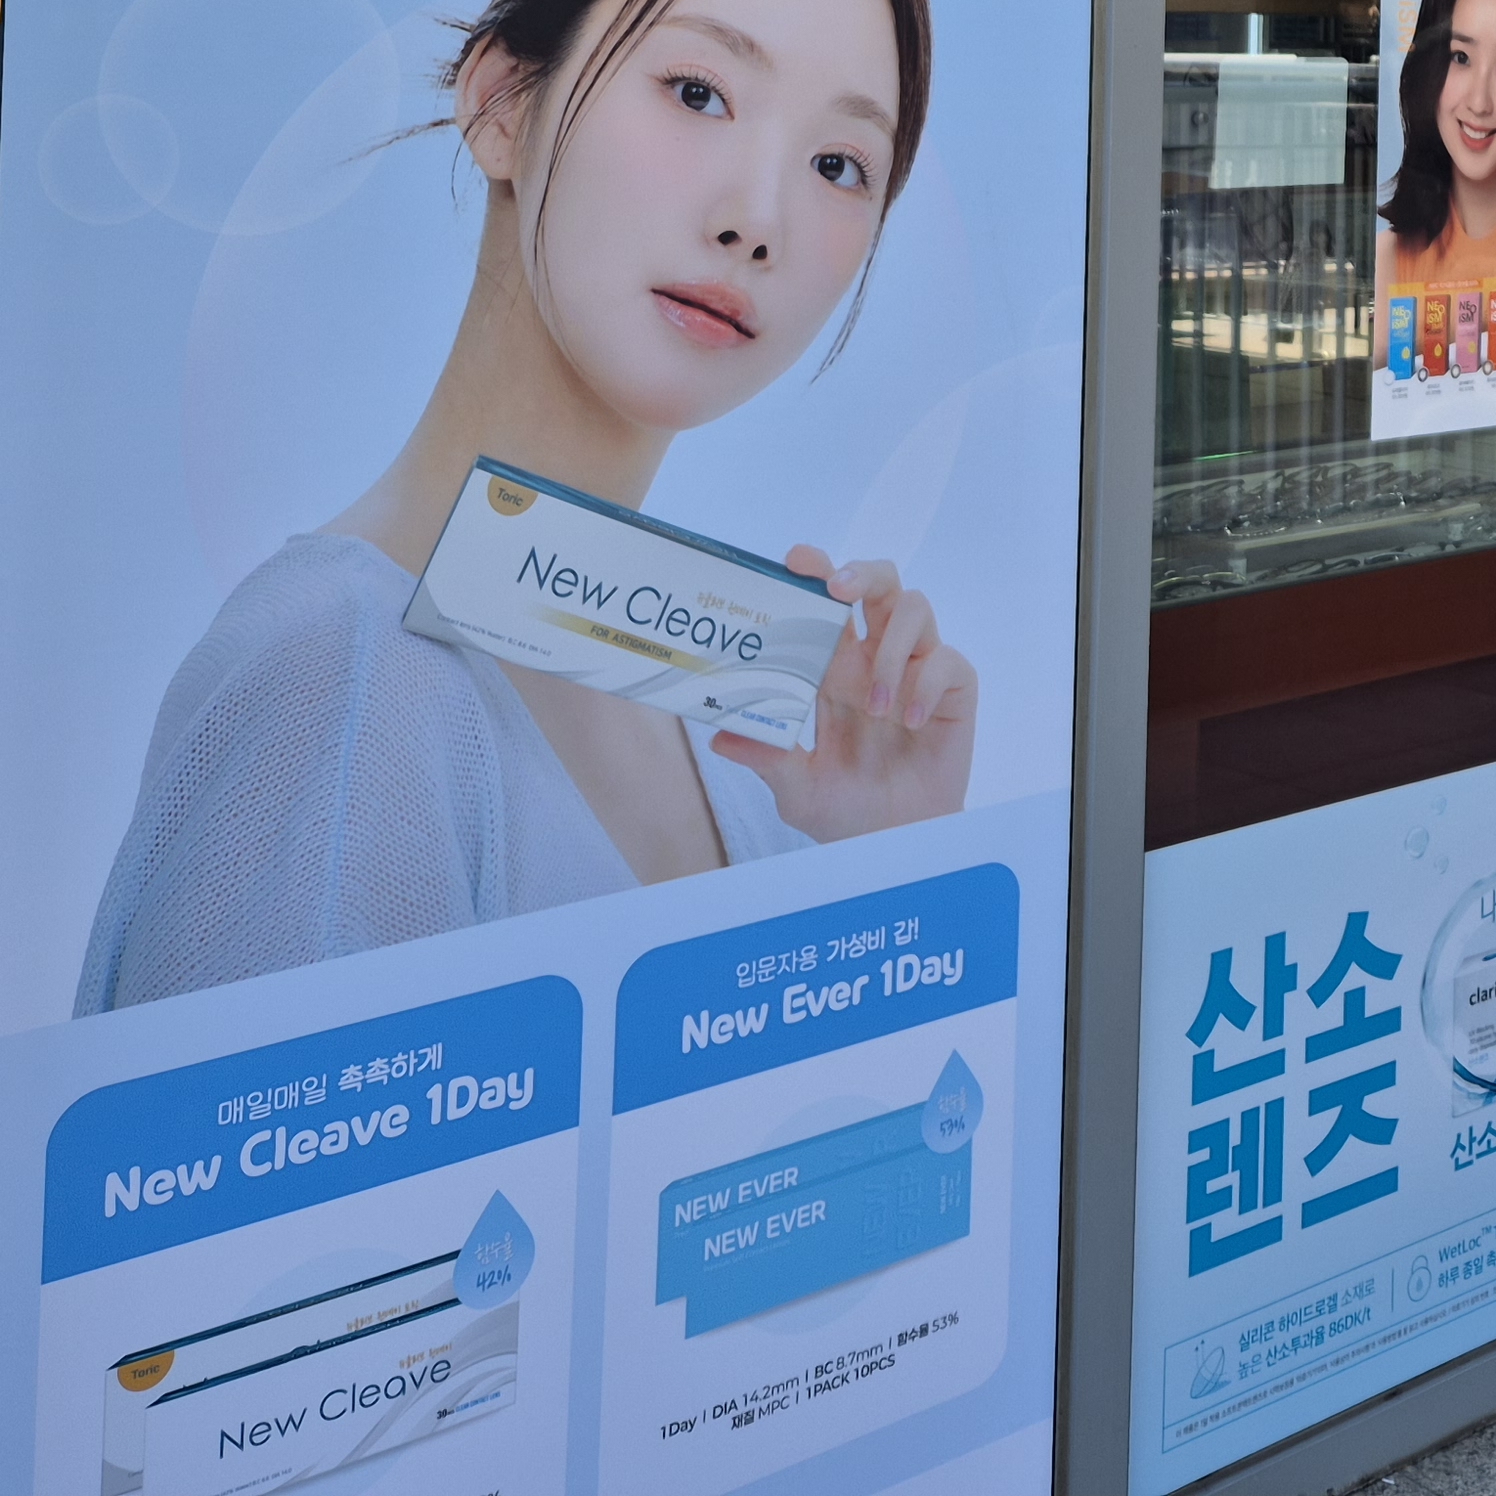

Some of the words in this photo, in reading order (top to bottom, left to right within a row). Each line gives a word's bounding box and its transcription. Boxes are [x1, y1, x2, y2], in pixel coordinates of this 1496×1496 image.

[1460, 301, 1477, 315] NEO
[496, 487, 524, 508] Toric
[516, 545, 619, 611] New
[625, 585, 763, 661] Cleave
[590, 625, 610, 639] FOR
[612, 633, 673, 661] ASTIGMATISM
[734, 943, 819, 989] 입문자용
[825, 927, 887, 965] 가성비
[893, 916, 920, 947] 갑!
[681, 1002, 768, 1054] New
[782, 974, 870, 1024] Ever
[881, 947, 965, 999] 1Day
[1184, 910, 1404, 1107] 산소
[217, 1073, 327, 1126] 매일매일
[337, 1042, 444, 1094] 촉촉하게
[103, 1153, 221, 1218] New
[239, 1103, 409, 1177] Cleave
[425, 1066, 535, 1127] 1Day
[939, 1115, 966, 1137] 53%
[674, 1187, 731, 1228] NEW
[738, 1166, 799, 1205] EVER
[1184, 1058, 1400, 1278] 렌즈
[703, 1222, 760, 1261] NEW
[766, 1200, 826, 1240] EVER
[476, 1266, 512, 1293] 42%
[1437, 1266, 1460, 1289] 하루
[1462, 1256, 1485, 1280] 종일
[1238, 1320, 1276, 1353] 실리콘
[1278, 1291, 1339, 1335] 하이드로겔
[1340, 1277, 1376, 1307] 소재로
[1238, 1355, 1262, 1381] 높은
[1265, 1325, 1326, 1367] 산소투과율
[1328, 1306, 1372, 1338] 86DK/t
[130, 1362, 161, 1381] Toric
[660, 1416, 698, 1440] 1Day
[712, 1399, 738, 1421] DIA
[742, 1375, 800, 1407] 14.2mm
[814, 1361, 834, 1379] BC
[836, 1341, 884, 1372] 8.7mm
[931, 1310, 960, 1335] 53%
[758, 1395, 791, 1419] MPC
[806, 1372, 851, 1399] 1PACK
[853, 1354, 896, 1383] 10PCS
[219, 1406, 308, 1460] New
[319, 1357, 452, 1424] Cleave
